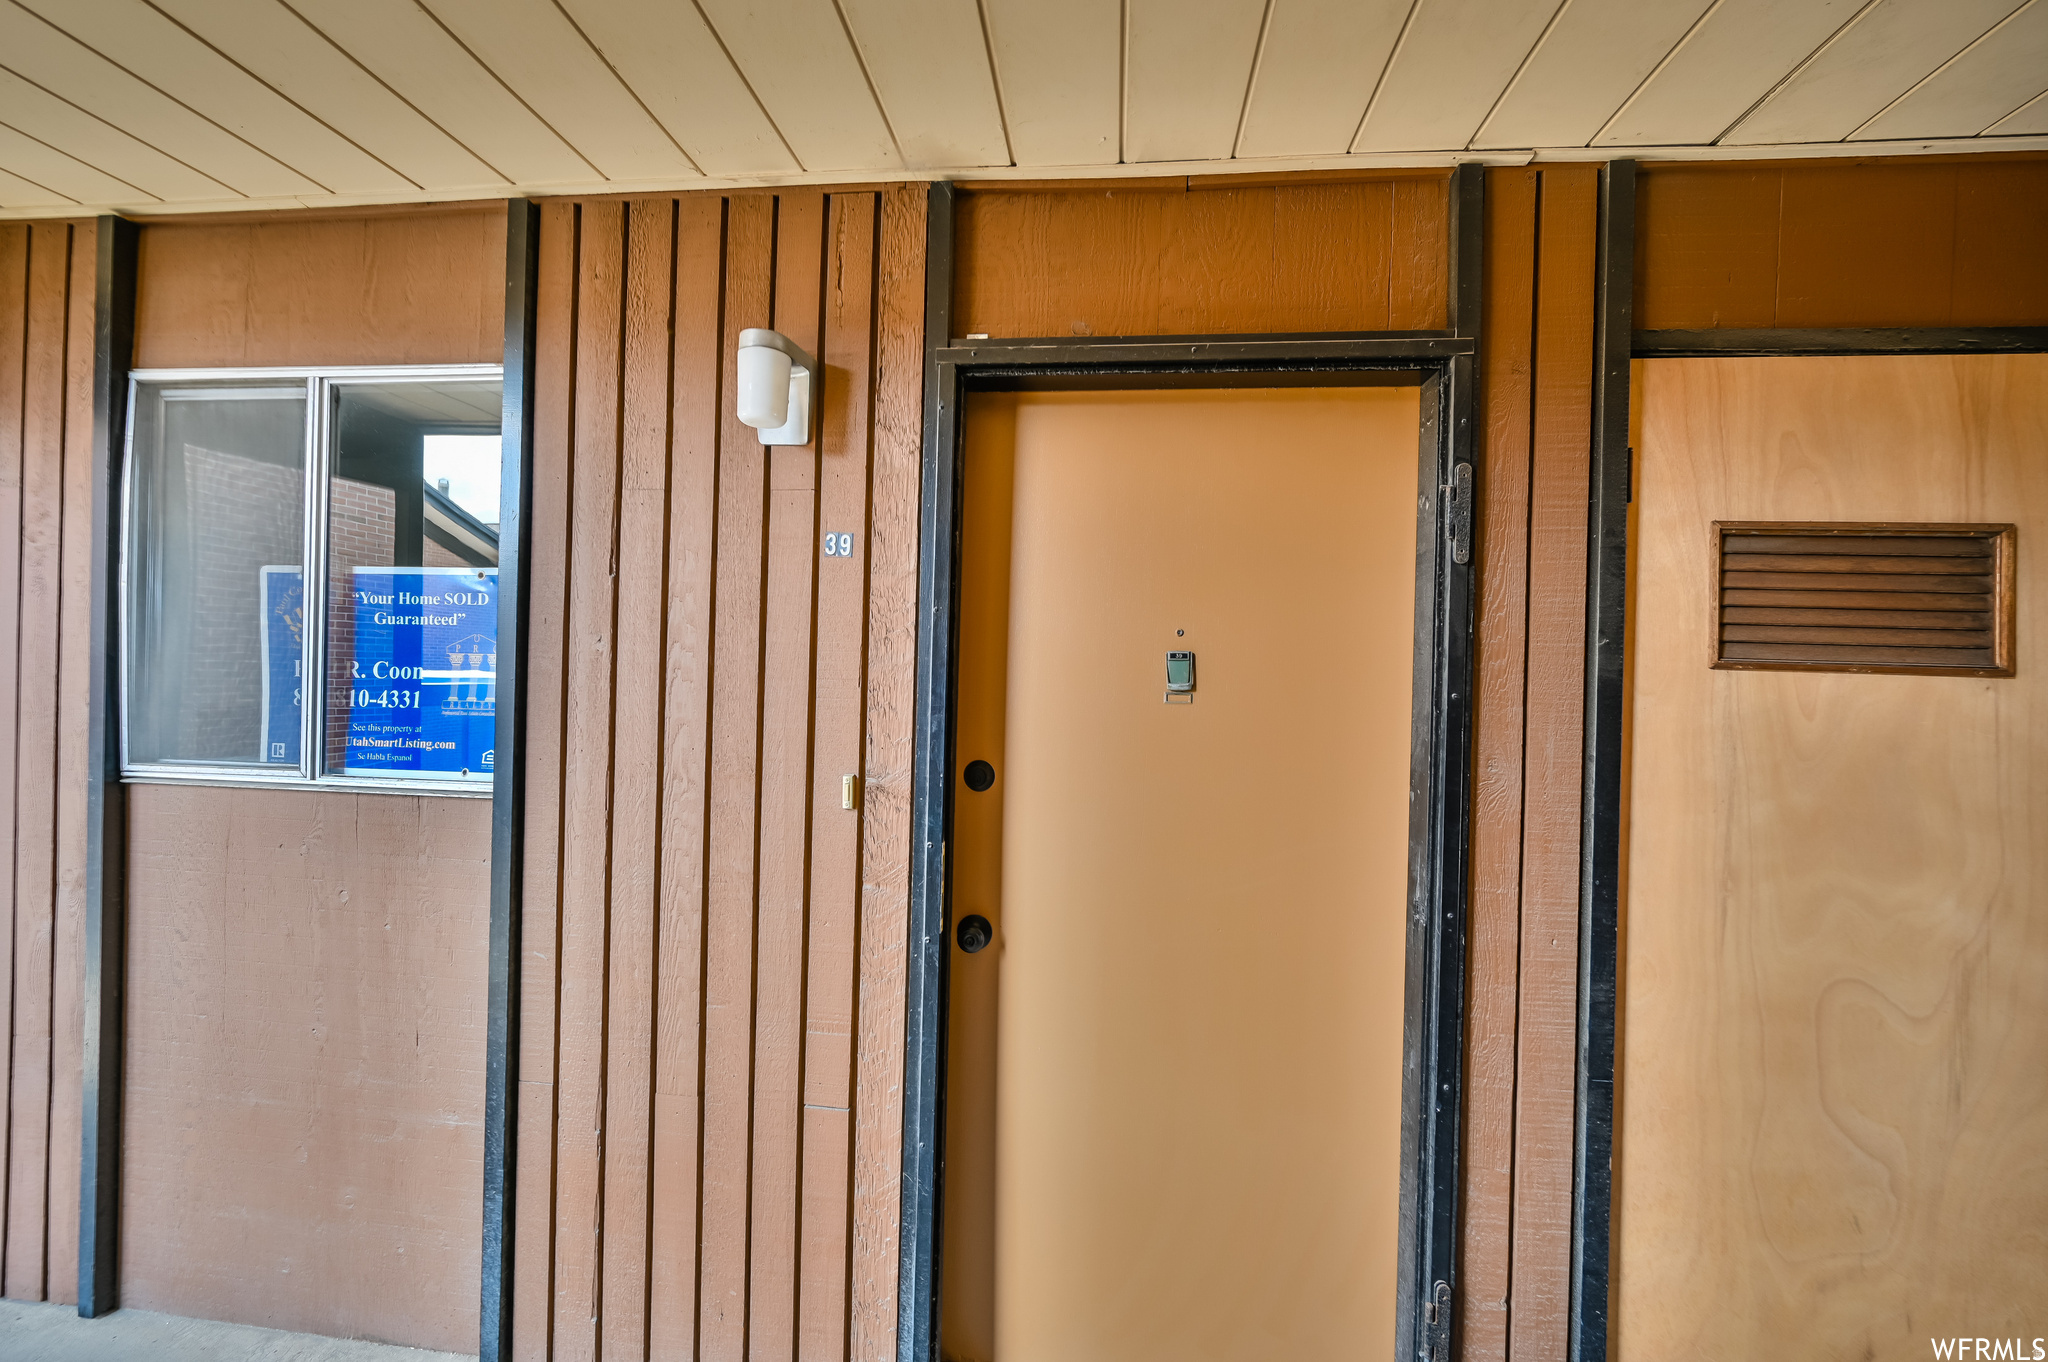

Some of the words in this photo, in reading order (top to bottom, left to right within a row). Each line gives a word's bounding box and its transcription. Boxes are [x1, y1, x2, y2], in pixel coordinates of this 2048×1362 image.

[825, 533, 851, 556] 39
[352, 592, 394, 605] “Your
[399, 592, 440, 605] Home
[444, 592, 489, 606] SOLD
[374, 612, 466, 626] Guaranteed”
[373, 660, 424, 679] Coon
[352, 723, 366, 732] See
[367, 723, 381, 732] this
[382, 724, 413, 734] property
[414, 725, 422, 733] at
[346, 736, 456, 751] UtahSmartListing.com
[357, 752, 366, 761] Se
[367, 753, 386, 761] Habla
[387, 753, 412, 763] Espanol
